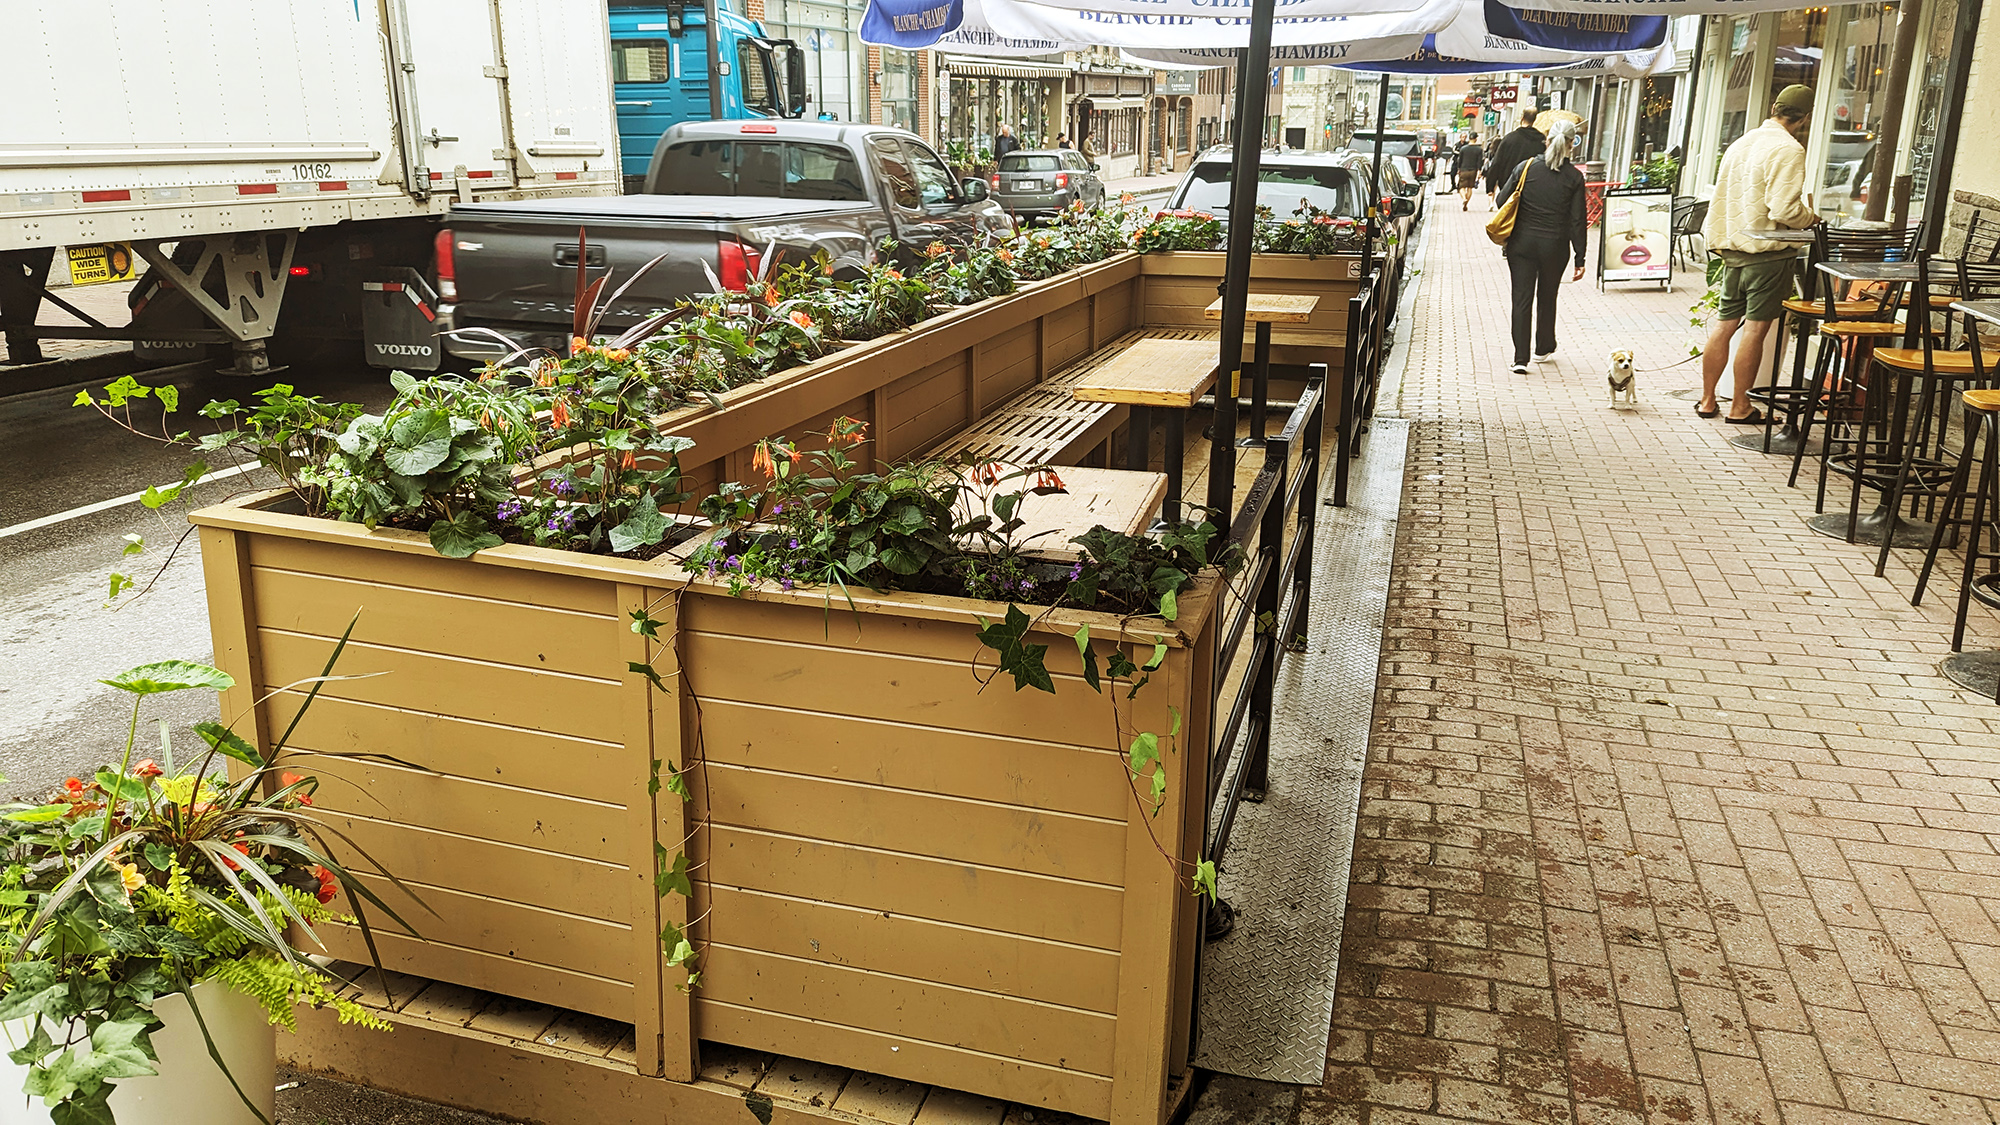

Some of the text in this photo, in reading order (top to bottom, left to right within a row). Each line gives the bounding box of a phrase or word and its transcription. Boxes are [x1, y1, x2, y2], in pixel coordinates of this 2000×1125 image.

[893, 14, 920, 32] BLANCHE
[1576, 13, 1632, 33] CHAMBLY
[945, 30, 995, 45] LANCHE
[292, 163, 332, 180] 10162
[69, 246, 105, 259] CAUTION
[76, 259, 101, 268] WIDE
[74, 270, 106, 280] TURNS
[374, 343, 433, 356] VOLVO
